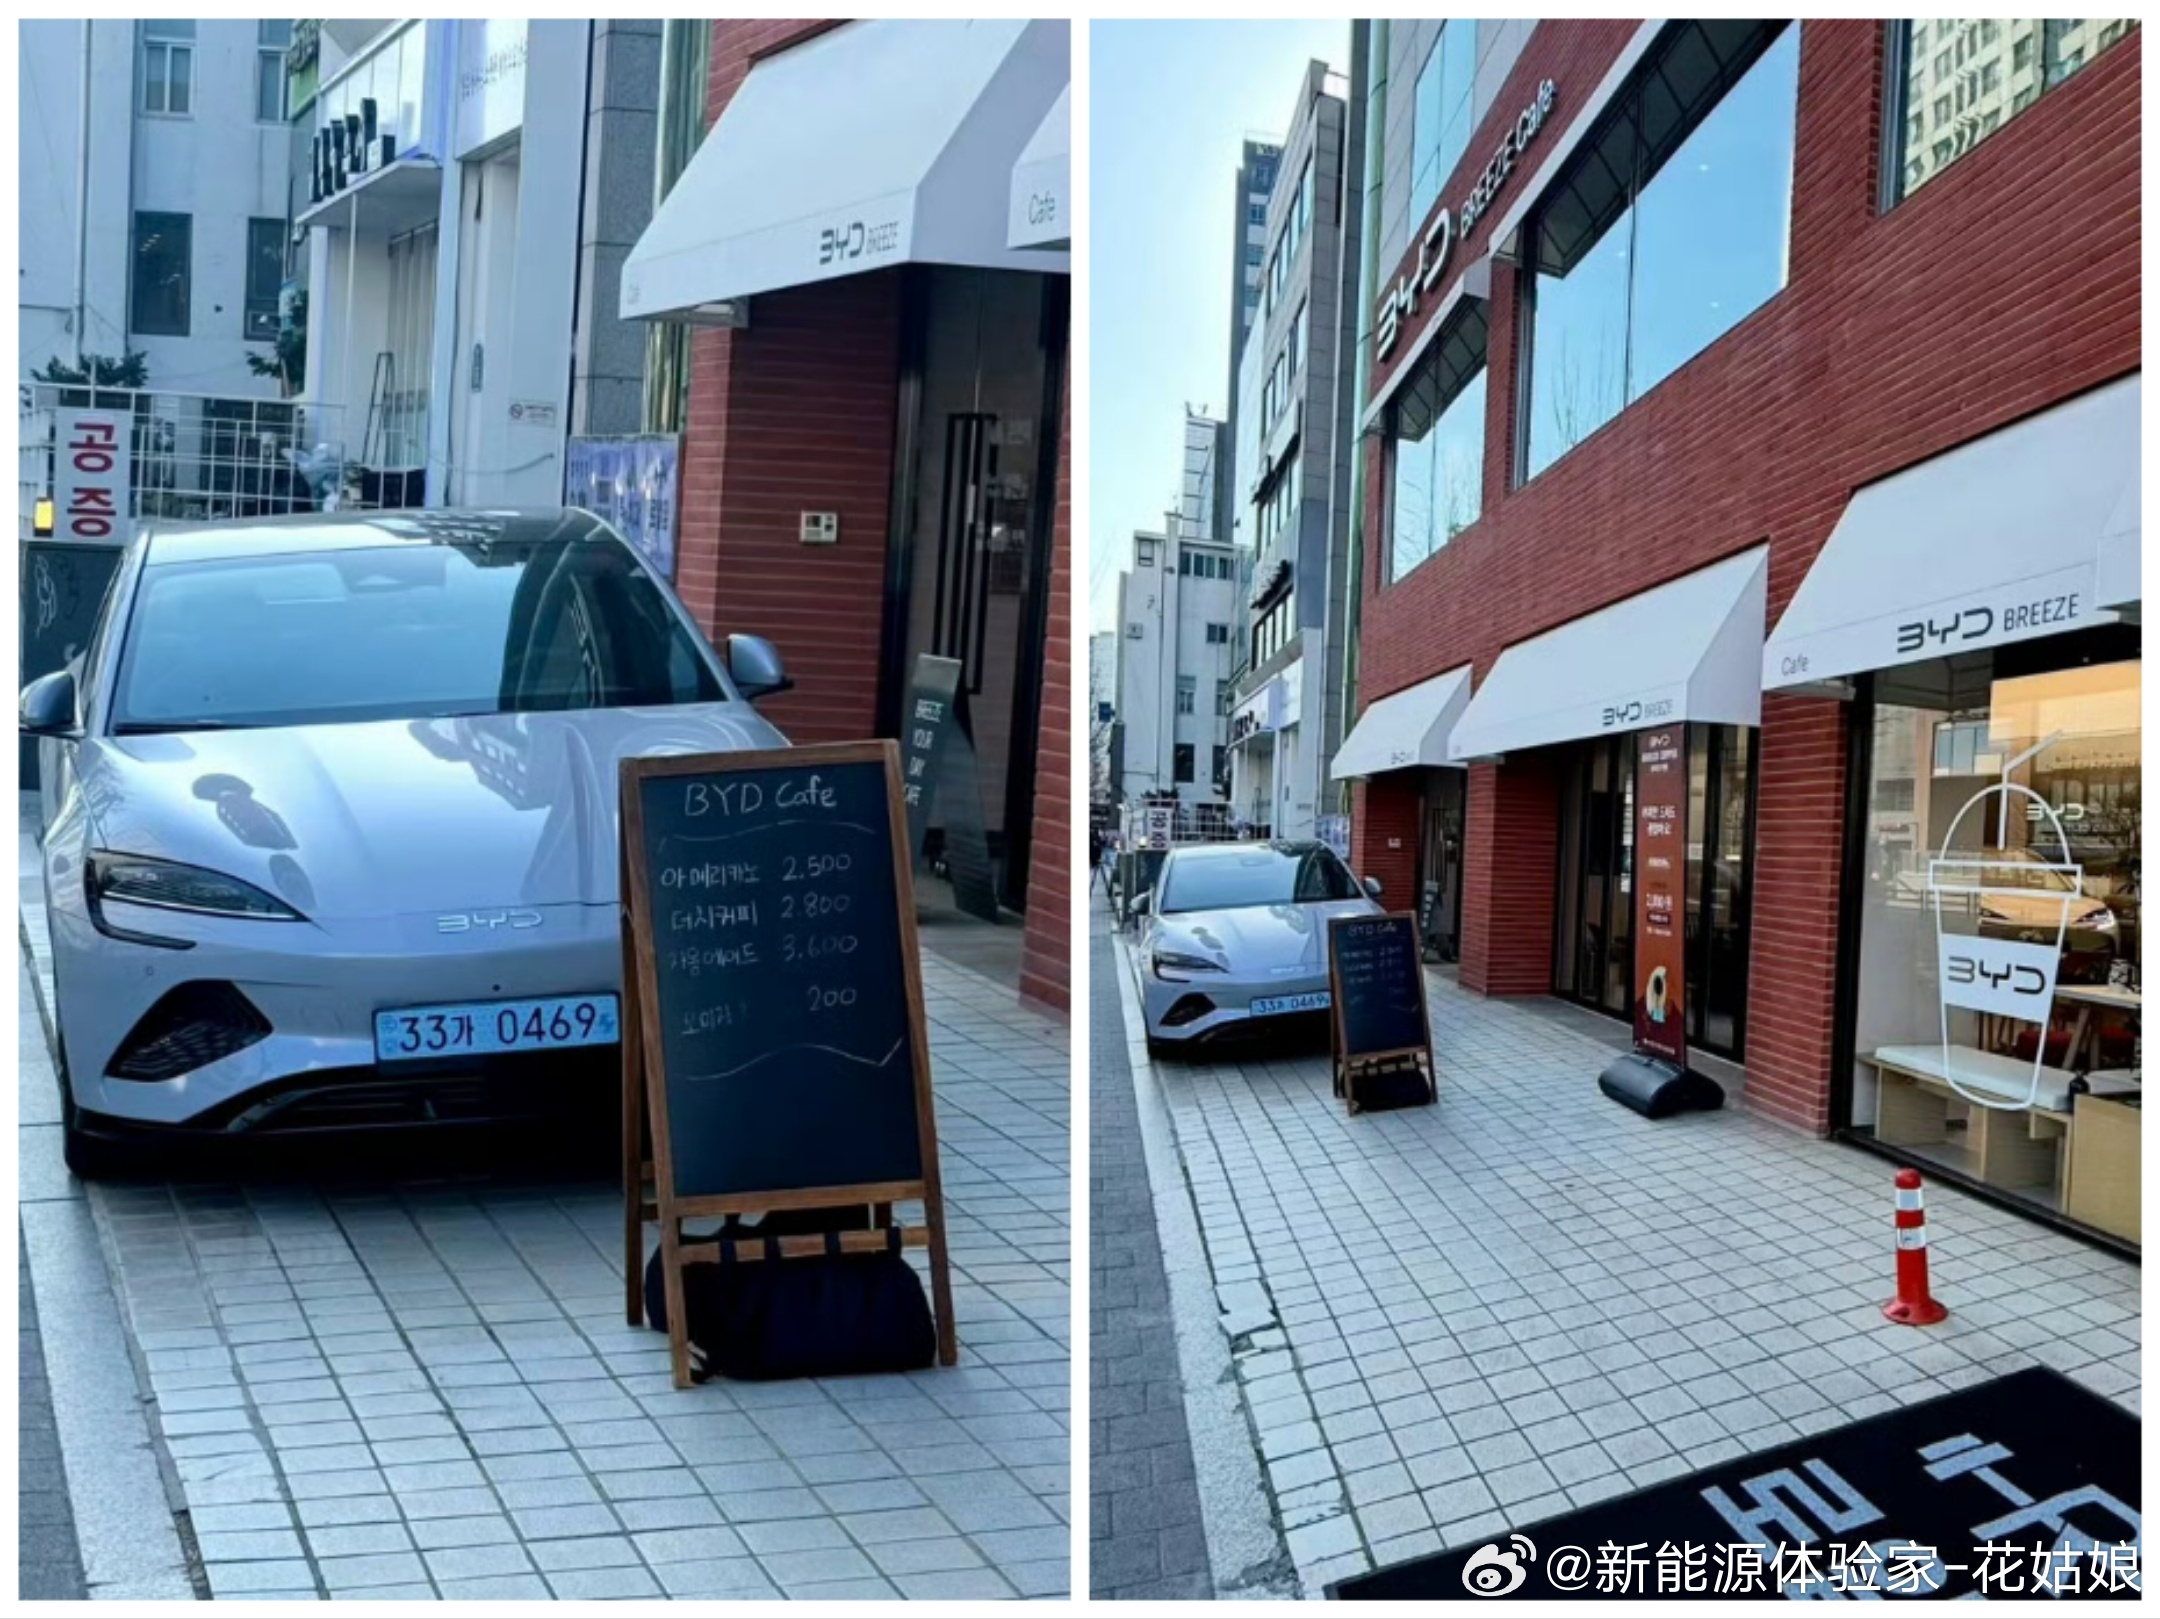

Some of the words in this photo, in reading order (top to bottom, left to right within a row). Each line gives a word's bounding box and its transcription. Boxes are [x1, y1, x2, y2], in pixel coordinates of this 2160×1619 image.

[1028, 189, 1056, 226] Cafe
[1377, 207, 1452, 362] BYD
[1460, 129, 1516, 239] BREEZE
[1515, 77, 1559, 151] Cafe
[819, 221, 865, 266] BYD
[866, 220, 900, 255] BREEZE
[68, 421, 119, 539] 공증
[1896, 607, 1994, 653] BYD
[2003, 594, 2080, 633] BREEZE
[1781, 654, 1809, 675] Cafe
[1602, 701, 1642, 727] BYD
[684, 781, 764, 817] BYD
[774, 773, 838, 809] Cafe
[2026, 801, 2085, 821] BYD
[660, 861, 760, 889] 아메리카노
[782, 853, 852, 882] 2.500
[436, 908, 542, 933] BYD
[670, 899, 758, 931] 더치커피
[780, 891, 852, 919] 2.800
[782, 933, 858, 963] 3.600
[1947, 956, 2047, 996] BYD
[398, 1014, 475, 1053] 33가
[496, 1001, 597, 1046] 0469
